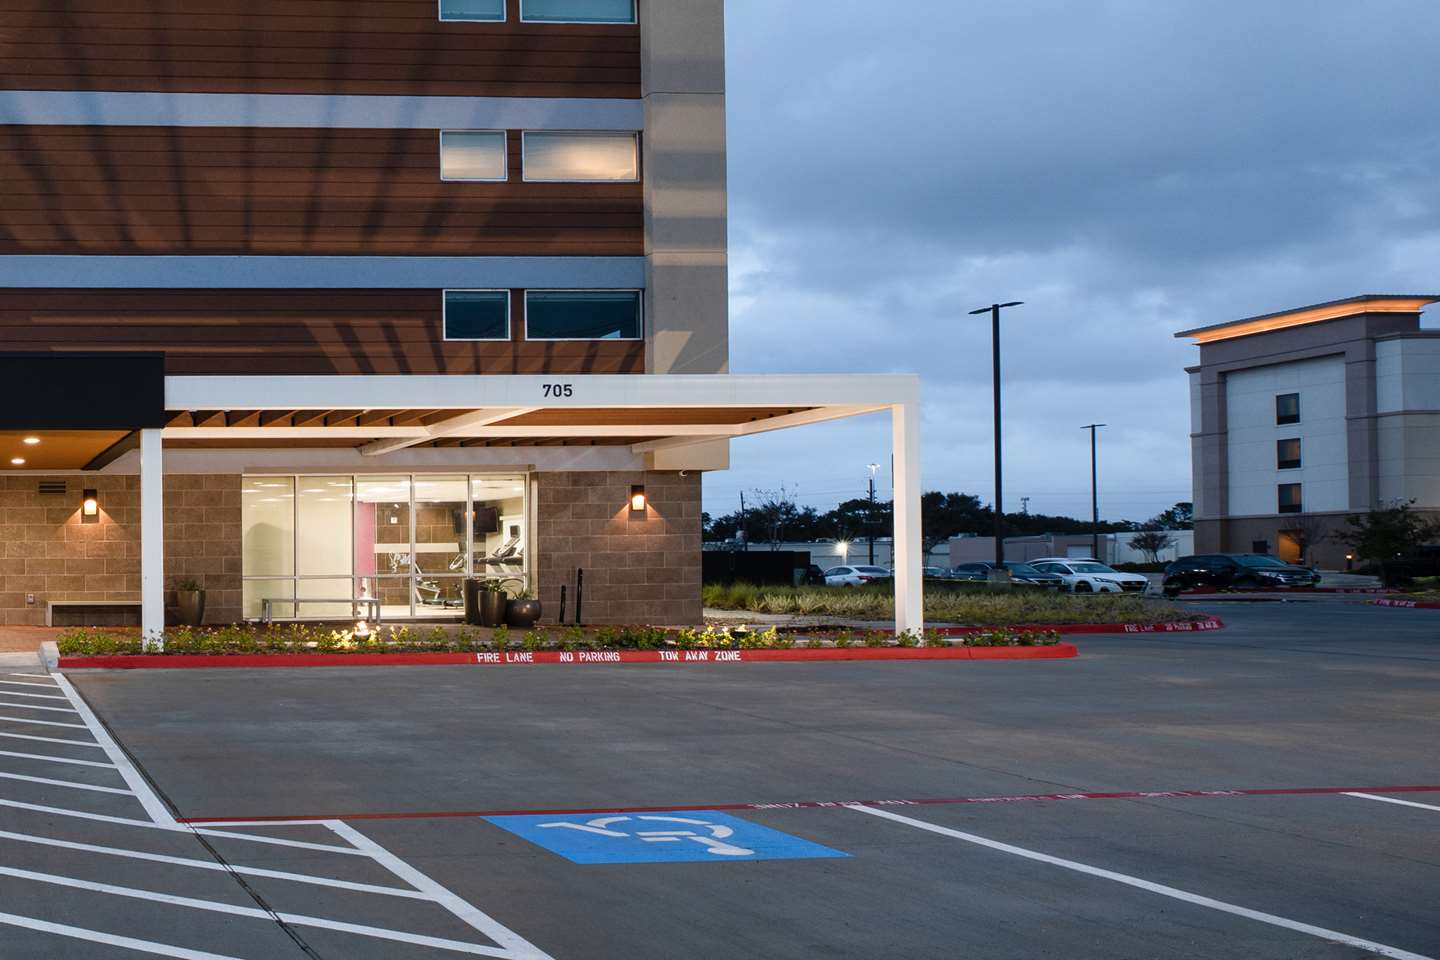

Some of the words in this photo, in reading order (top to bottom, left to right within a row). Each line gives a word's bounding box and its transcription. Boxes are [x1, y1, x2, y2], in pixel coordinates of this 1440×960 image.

[542, 384, 573, 398] 705
[477, 652, 500, 663] FIRE
[506, 652, 533, 663] LANE
[560, 651, 574, 662] NO
[579, 651, 620, 662] PARKING
[659, 650, 679, 661] TOW
[685, 650, 708, 661] AWAY
[715, 650, 742, 661] ZONE
